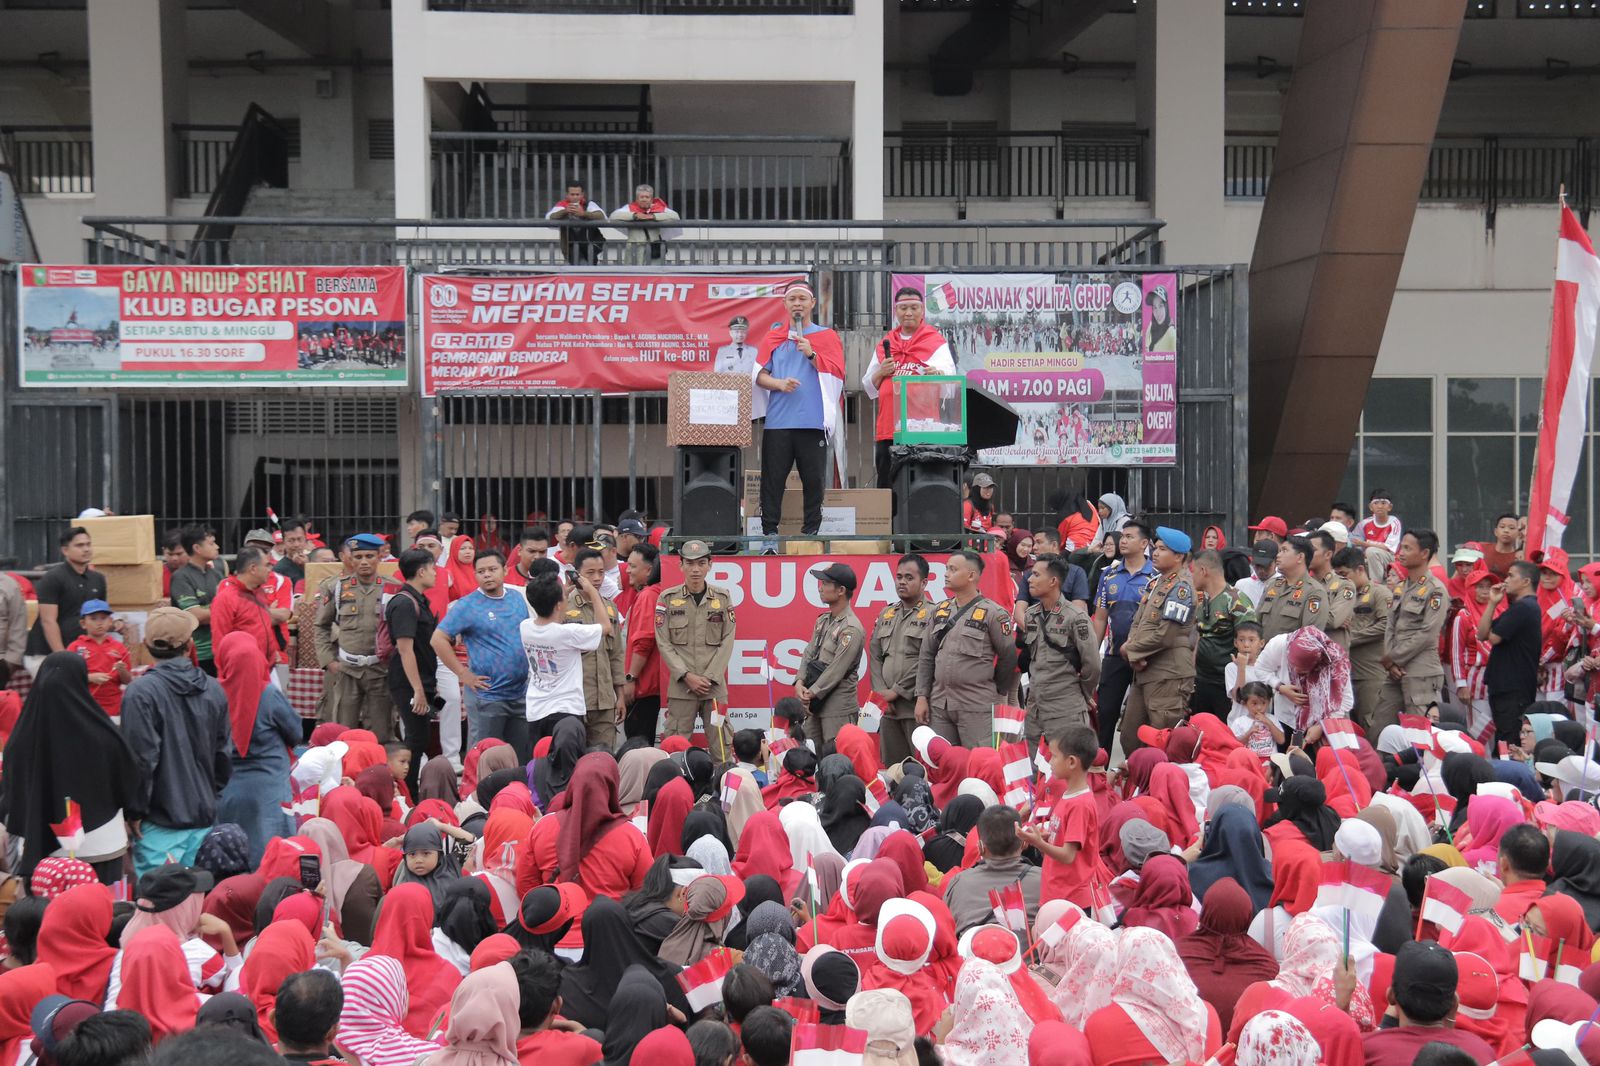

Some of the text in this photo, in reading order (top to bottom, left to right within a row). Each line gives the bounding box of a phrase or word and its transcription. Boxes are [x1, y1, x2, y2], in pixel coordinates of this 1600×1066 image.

[123, 270, 307, 294] GAYA HIDUP SEHAT
[315, 277, 378, 293] BERSAMA
[431, 284, 458, 307] 80
[471, 283, 694, 302] SENAM SEHAT
[1026, 285, 1072, 311] SULITA
[1075, 284, 1112, 310] GRUP
[124, 297, 378, 316] KLUB BUGAR PESONA
[471, 304, 629, 323] MERDEKA
[125, 326, 275, 336] SETIAP SABTU & MINGGU
[434, 335, 512, 346] GRATIS
[136, 348, 246, 358] PUKUL 16.30 SORE
[431, 351, 568, 363] PEMBAGIAN BENDERA
[640, 350, 661, 362] HUT
[664, 350, 695, 362] ke-80
[699, 350, 710, 362] RI
[990, 358, 1078, 368] HADIR SETIAP MINGGU
[431, 366, 519, 378] MERAH PUTIH
[1022, 379, 1053, 396] 7.00
[1058, 379, 1092, 396] PAGI
[1145, 384, 1174, 401] SULITA
[1147, 411, 1172, 429] OKEY!
[1164, 600, 1190, 622] PTI
[729, 711, 758, 720] dan Spa
